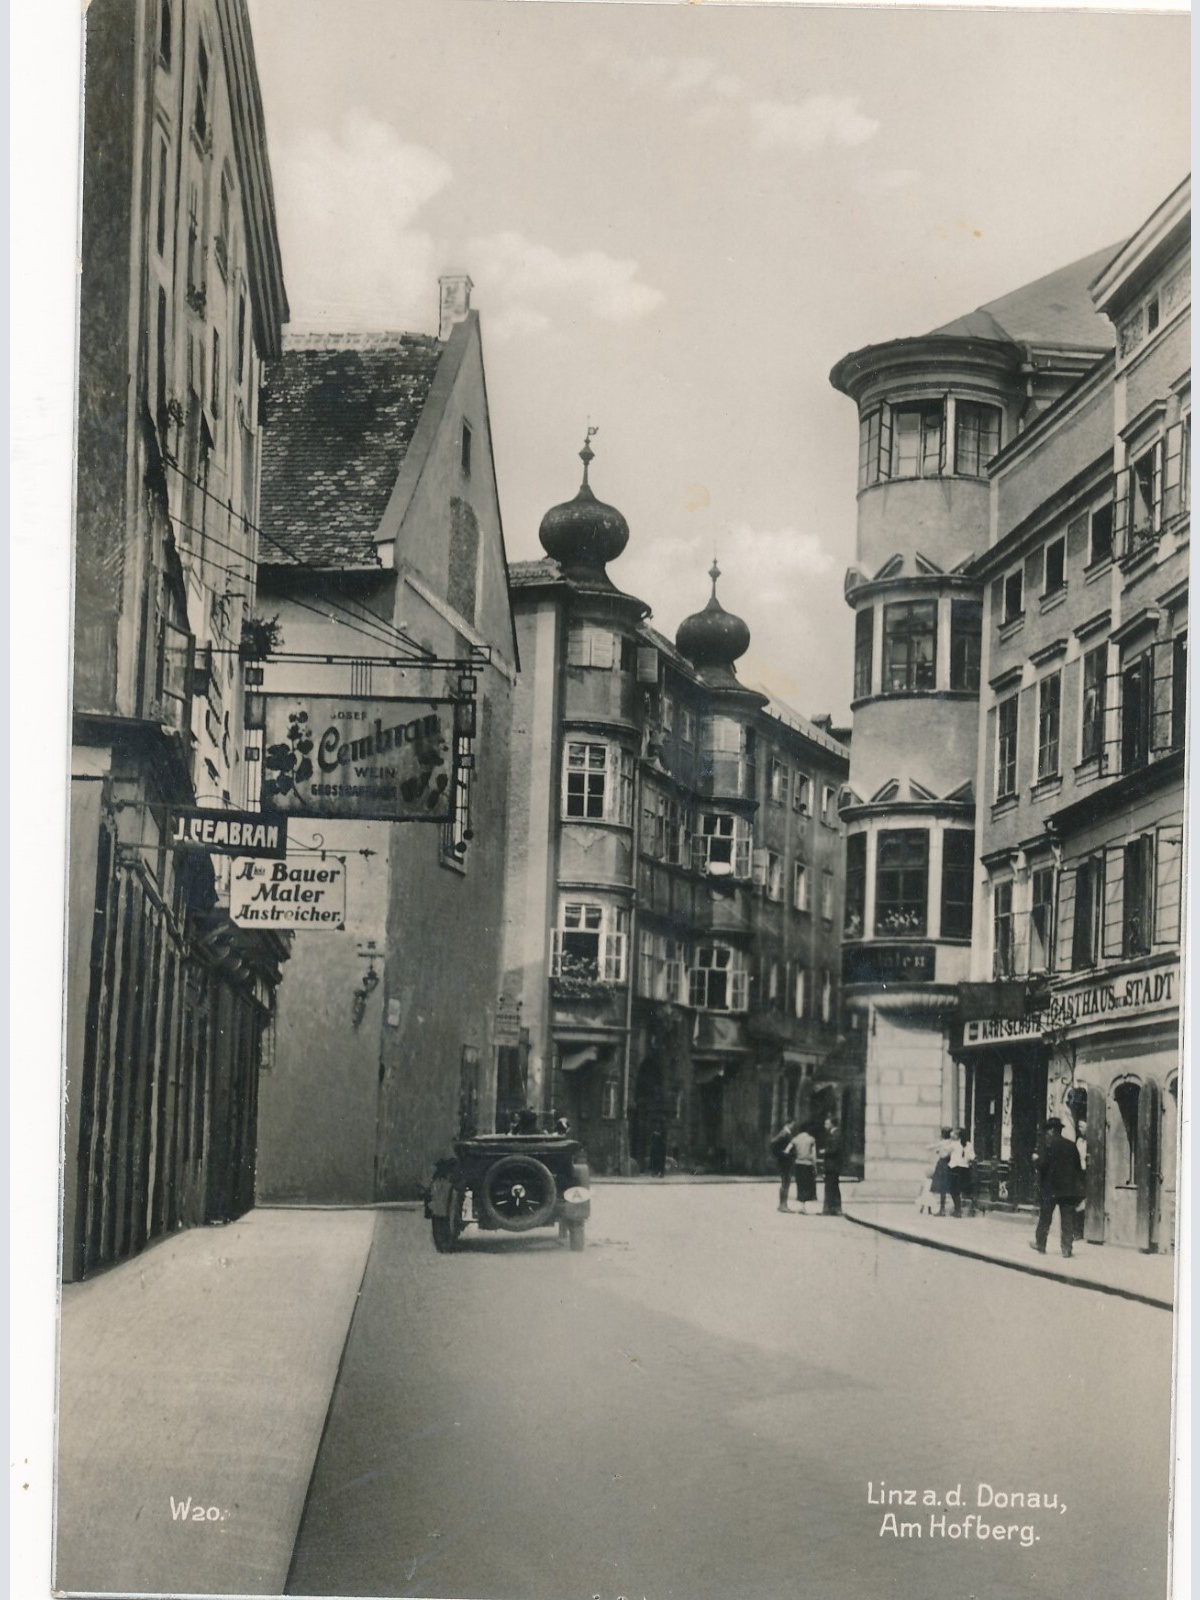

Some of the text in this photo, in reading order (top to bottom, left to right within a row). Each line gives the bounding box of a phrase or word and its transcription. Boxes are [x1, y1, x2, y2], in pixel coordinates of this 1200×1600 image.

[318, 714, 441, 773] Cembran
[354, 766, 396, 778] WEIN
[172, 817, 278, 848] J. CEMBRAN
[270, 863, 341, 883] Bauer
[251, 883, 325, 903] Maler
[234, 904, 341, 922] Anstreicher.
[1050, 985, 1116, 1025] GASTHAUS
[1126, 972, 1174, 1006] STADT
